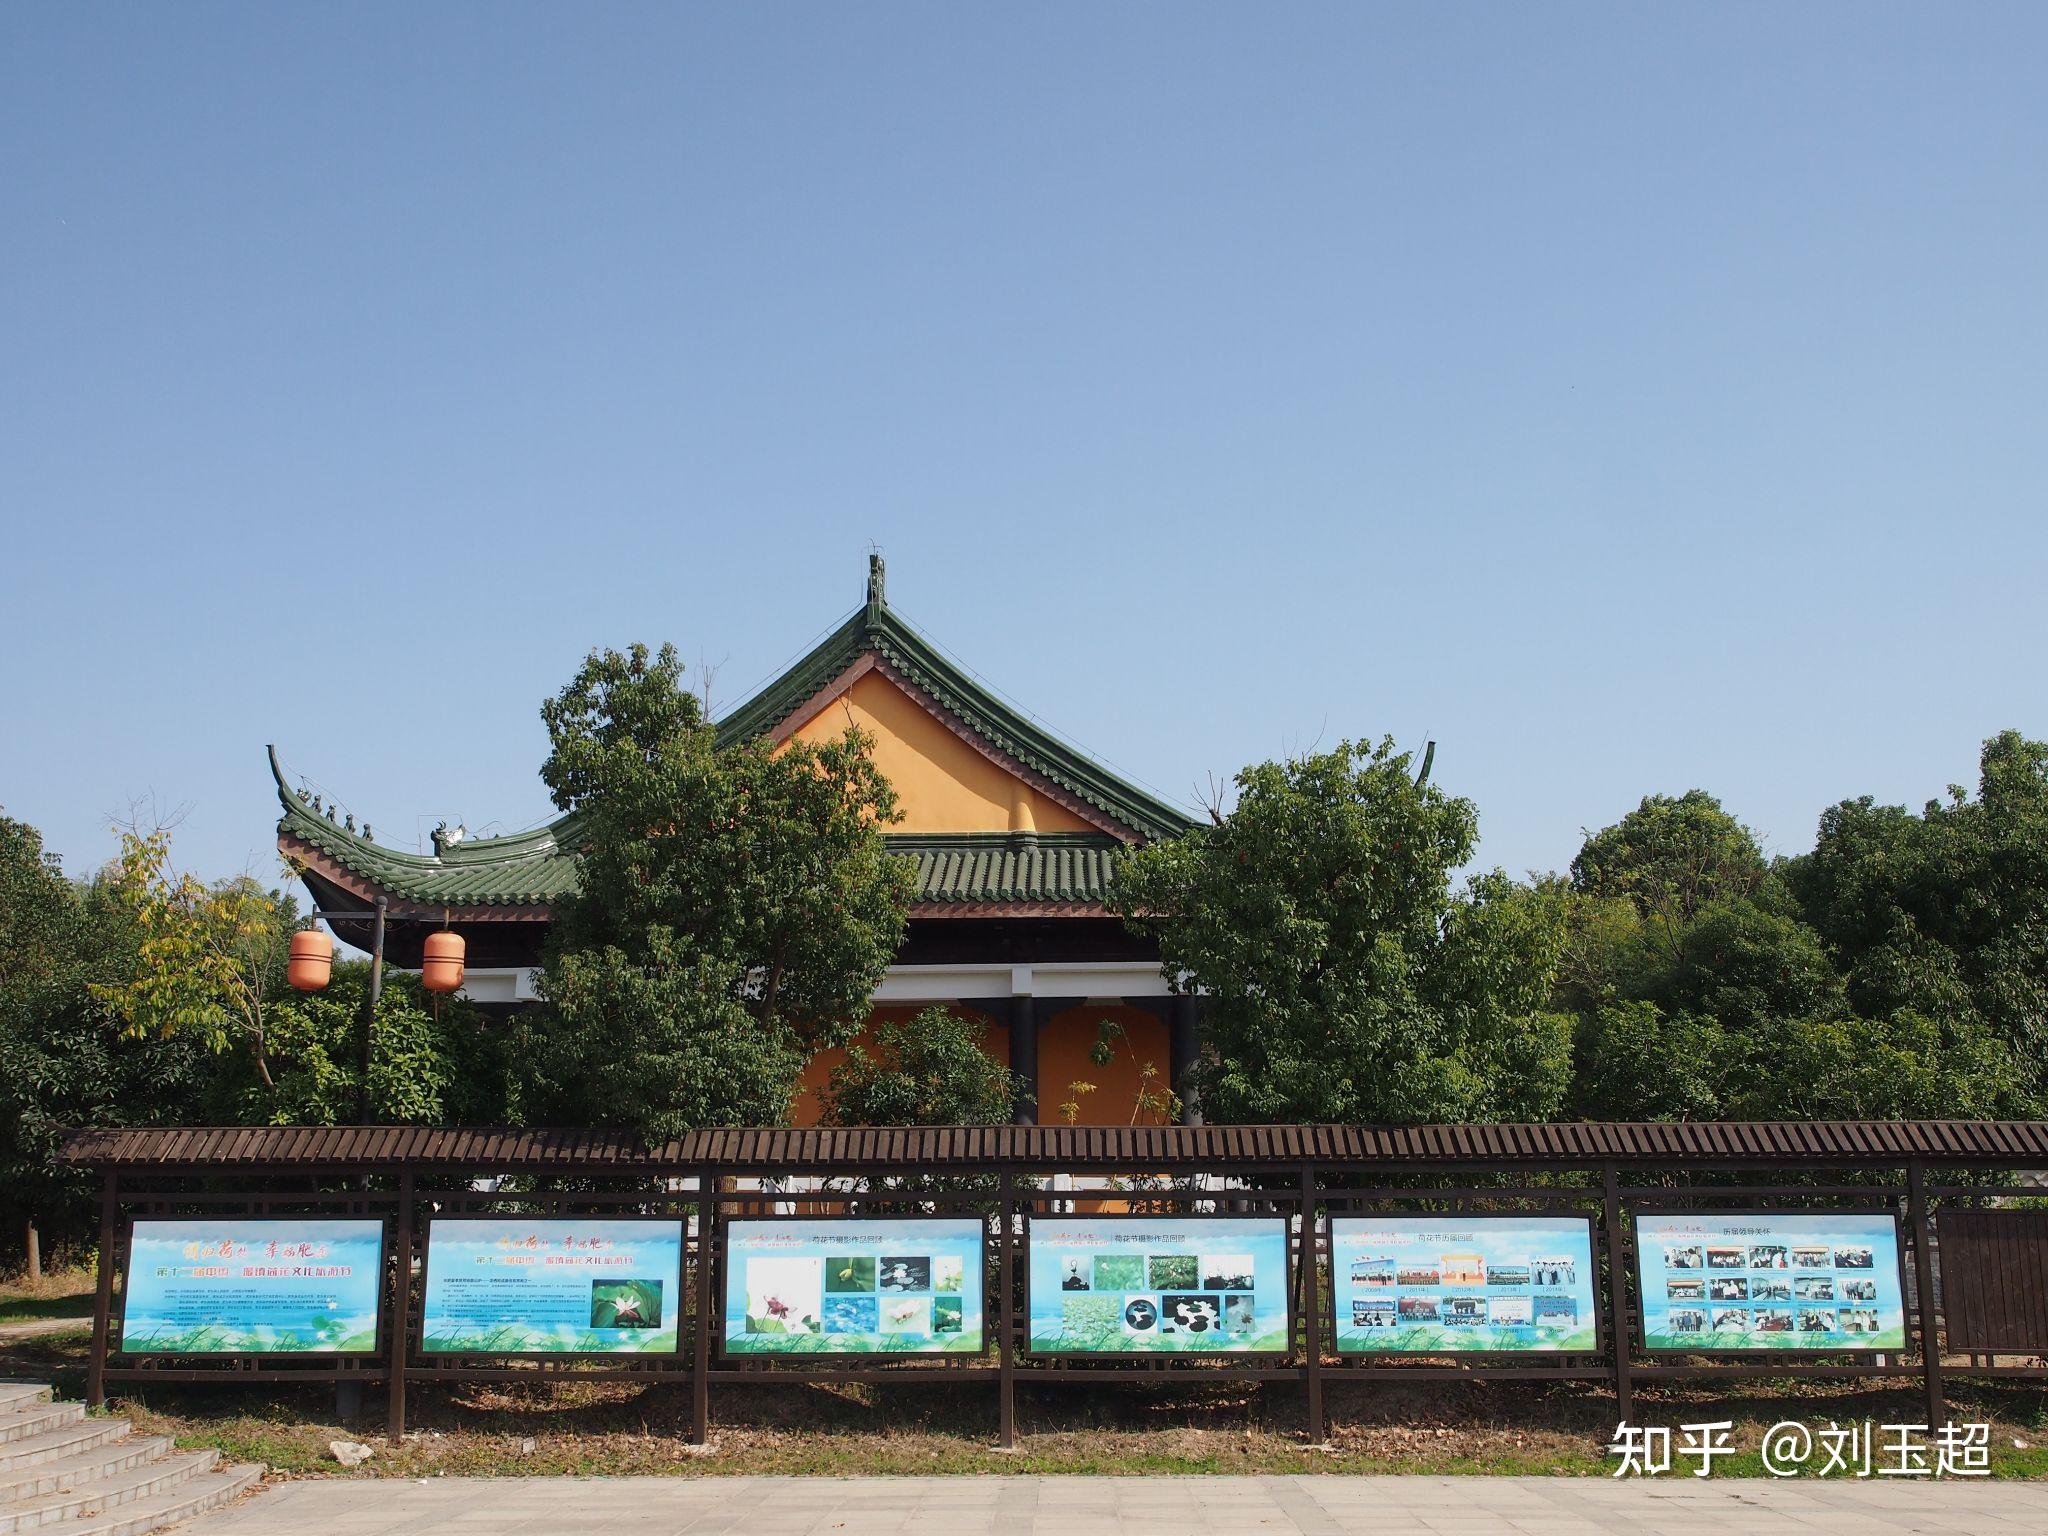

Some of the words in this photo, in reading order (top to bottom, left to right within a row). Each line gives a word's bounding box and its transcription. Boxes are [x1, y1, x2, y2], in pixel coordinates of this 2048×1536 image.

[1115, 1234, 1185, 1243] 荷花节摄影作品回顾
